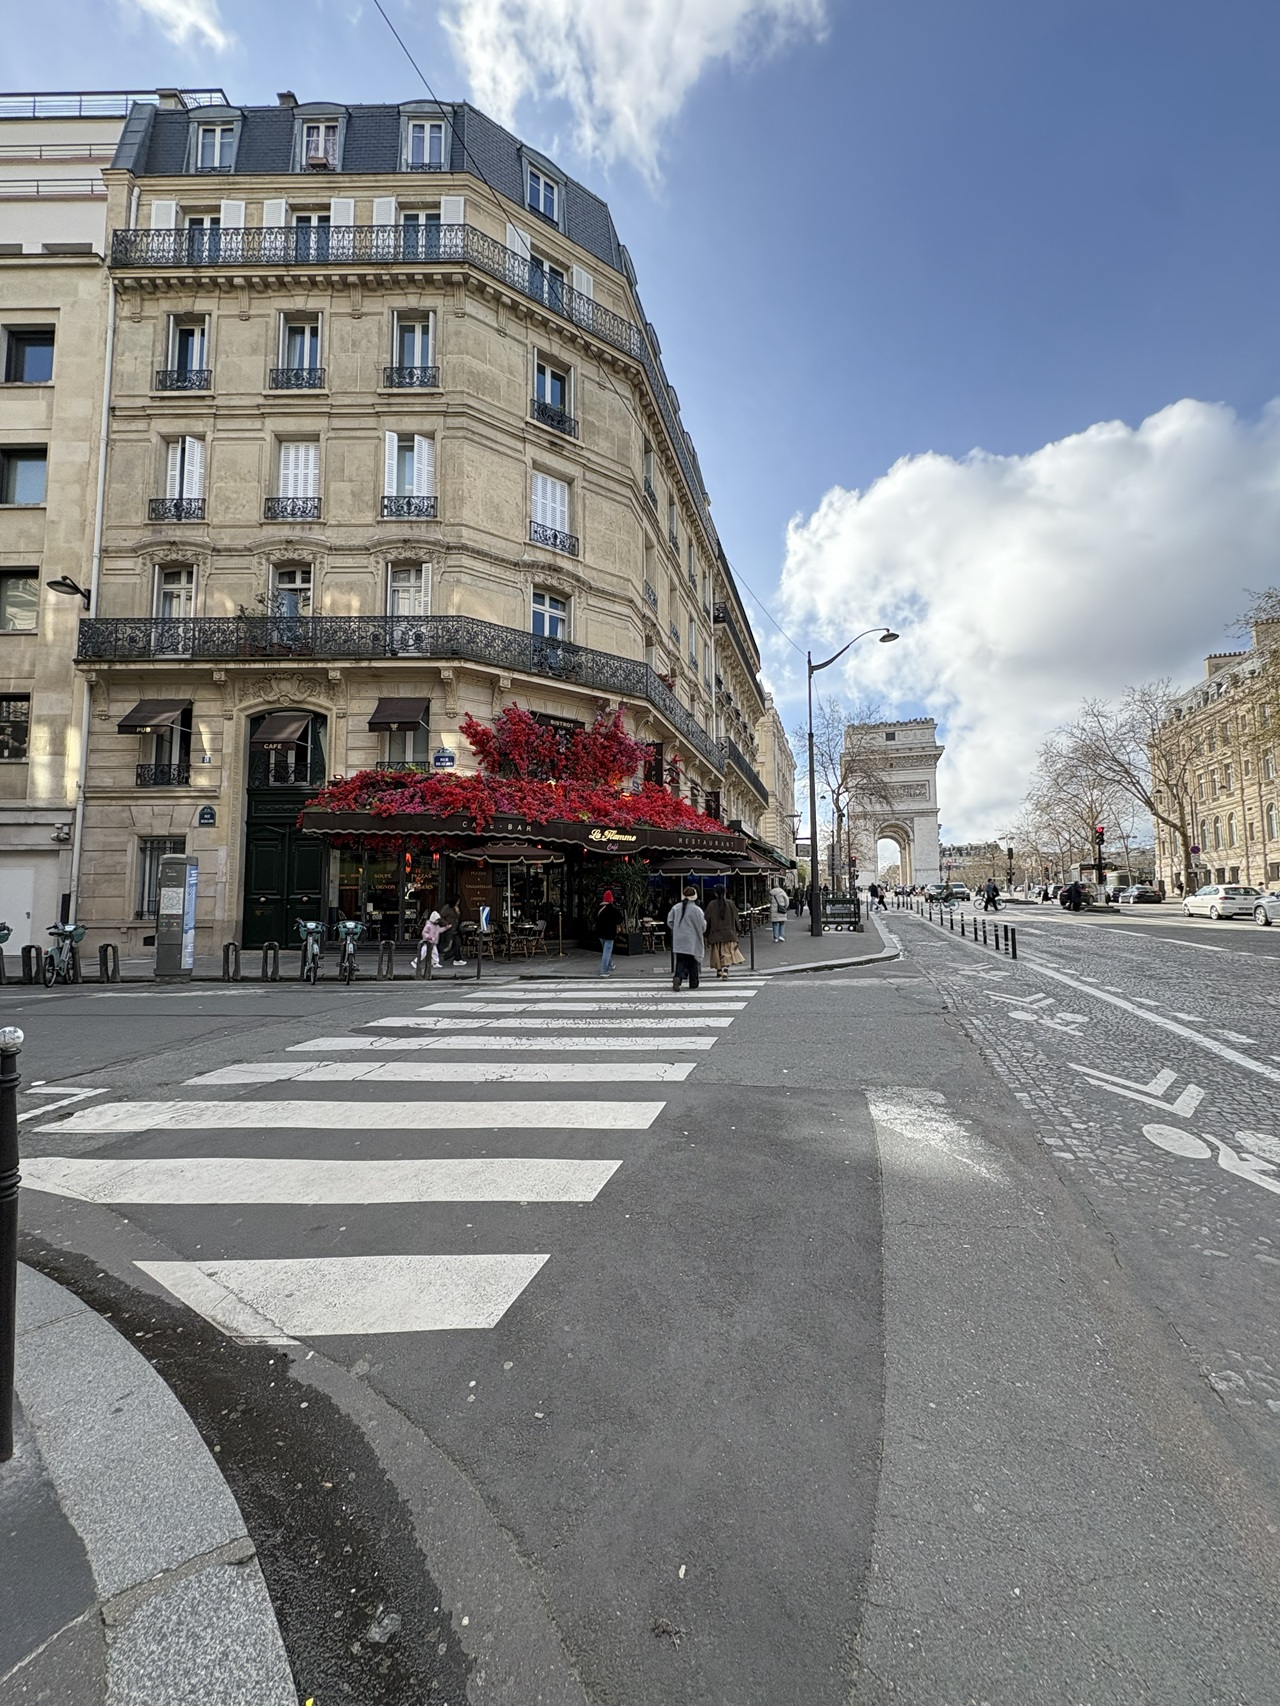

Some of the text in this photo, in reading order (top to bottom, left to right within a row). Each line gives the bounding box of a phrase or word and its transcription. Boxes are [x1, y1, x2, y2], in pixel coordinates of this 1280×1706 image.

[588, 828, 637, 841] La Flamme
[678, 837, 735, 848] RESTAURANT
